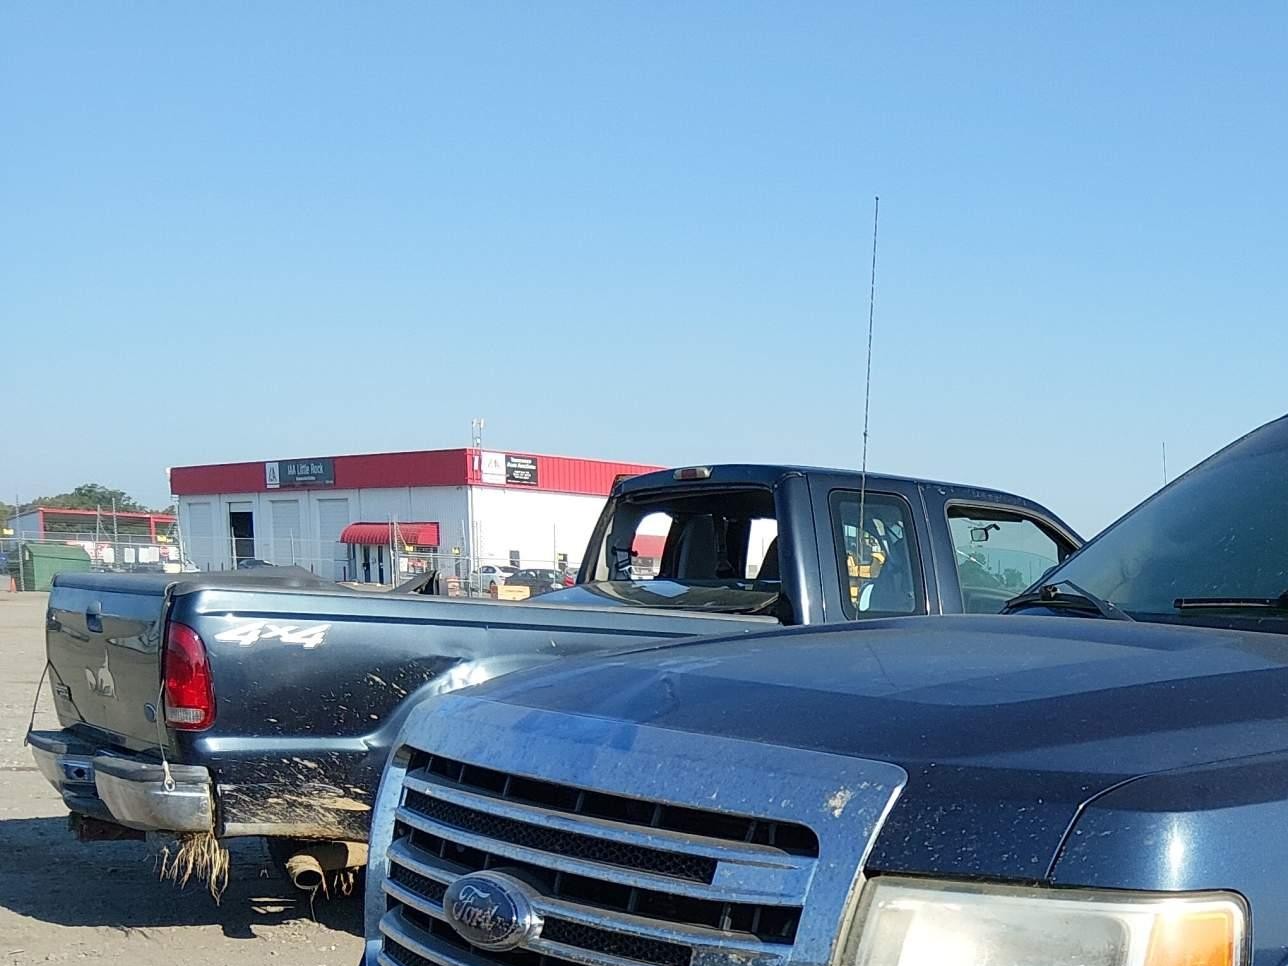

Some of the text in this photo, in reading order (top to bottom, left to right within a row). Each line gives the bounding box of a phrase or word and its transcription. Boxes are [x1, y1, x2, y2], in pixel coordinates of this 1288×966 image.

[296, 464, 310, 475] Little
[310, 462, 324, 475] Rock
[451, 884, 499, 932] Ford
